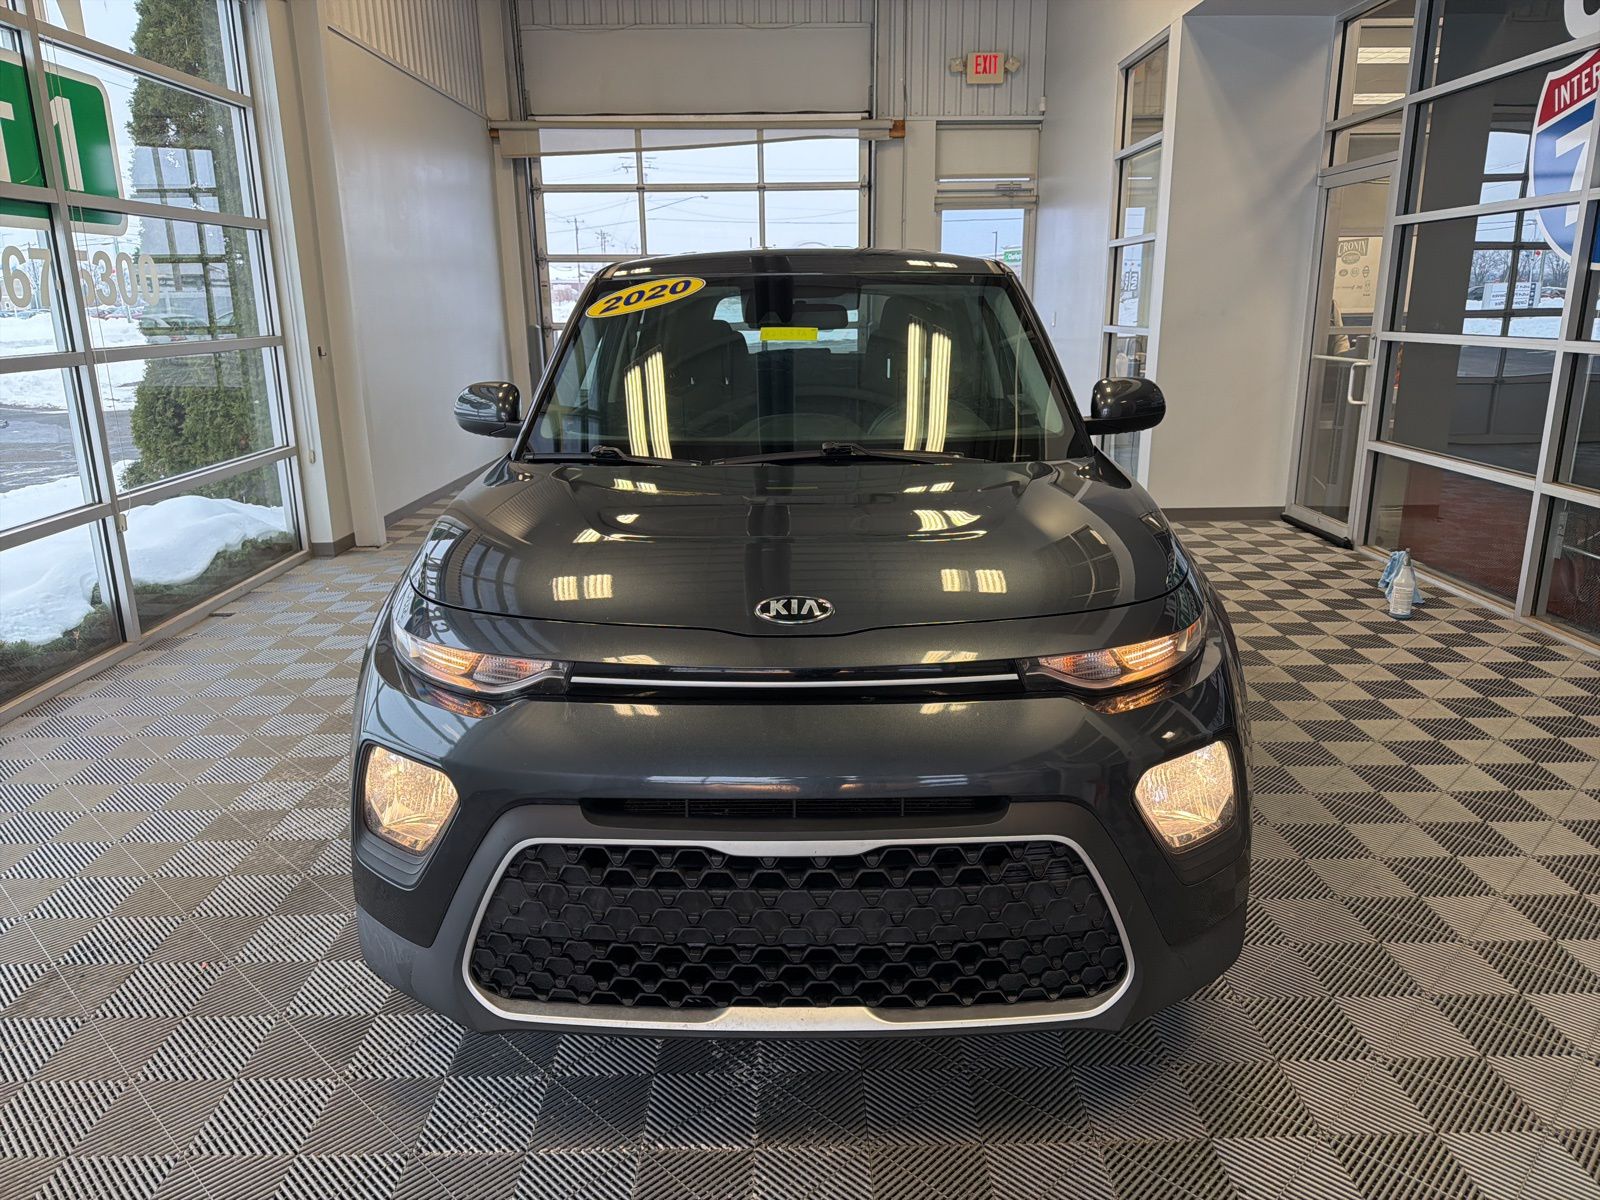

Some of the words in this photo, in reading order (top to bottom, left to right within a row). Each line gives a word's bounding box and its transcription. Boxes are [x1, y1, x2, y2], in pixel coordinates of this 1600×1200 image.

[974, 54, 999, 75] EXIT
[598, 279, 692, 315] 2020
[769, 598, 822, 617] KIA
